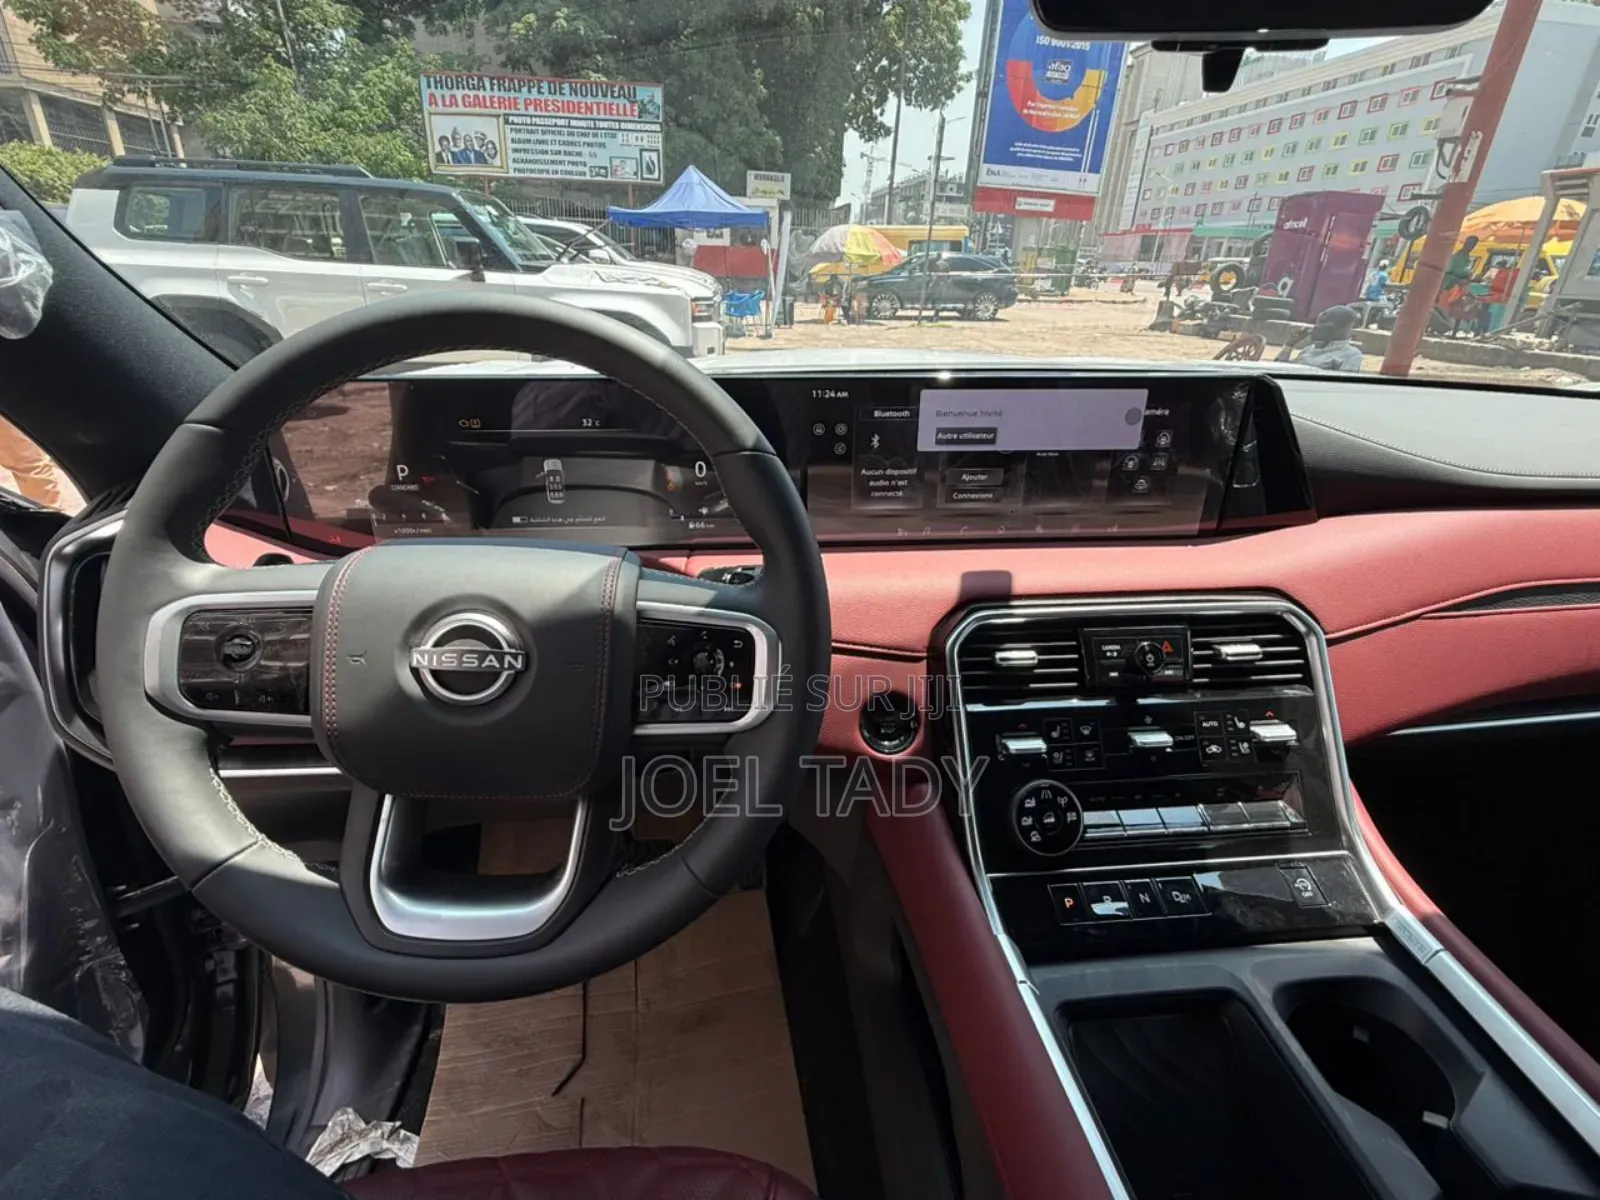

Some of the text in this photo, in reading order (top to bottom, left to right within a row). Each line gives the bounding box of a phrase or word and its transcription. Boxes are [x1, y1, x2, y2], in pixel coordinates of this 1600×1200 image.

[1036, 35, 1050, 45] ISO
[424, 75, 637, 99] THORGA FRAPPE DE NOUVEAU
[441, 93, 459, 108] LA
[461, 93, 521, 111] GALERIE
[508, 116, 532, 125] PHOTO
[509, 127, 540, 135] PORTRAIT
[511, 147, 549, 156] IMPRESSION
[812, 389, 849, 399] 11:24 AM
[873, 409, 911, 418] Bluetooth
[1143, 407, 1170, 416] améra
[396, 464, 409, 481] P
[695, 460, 707, 478] 0
[860, 467, 885, 476] Aucun
[961, 472, 989, 482] Ajouter
[412, 651, 523, 669] NISSAN
[1064, 897, 1074, 909] P
[1138, 892, 1151, 904] N
